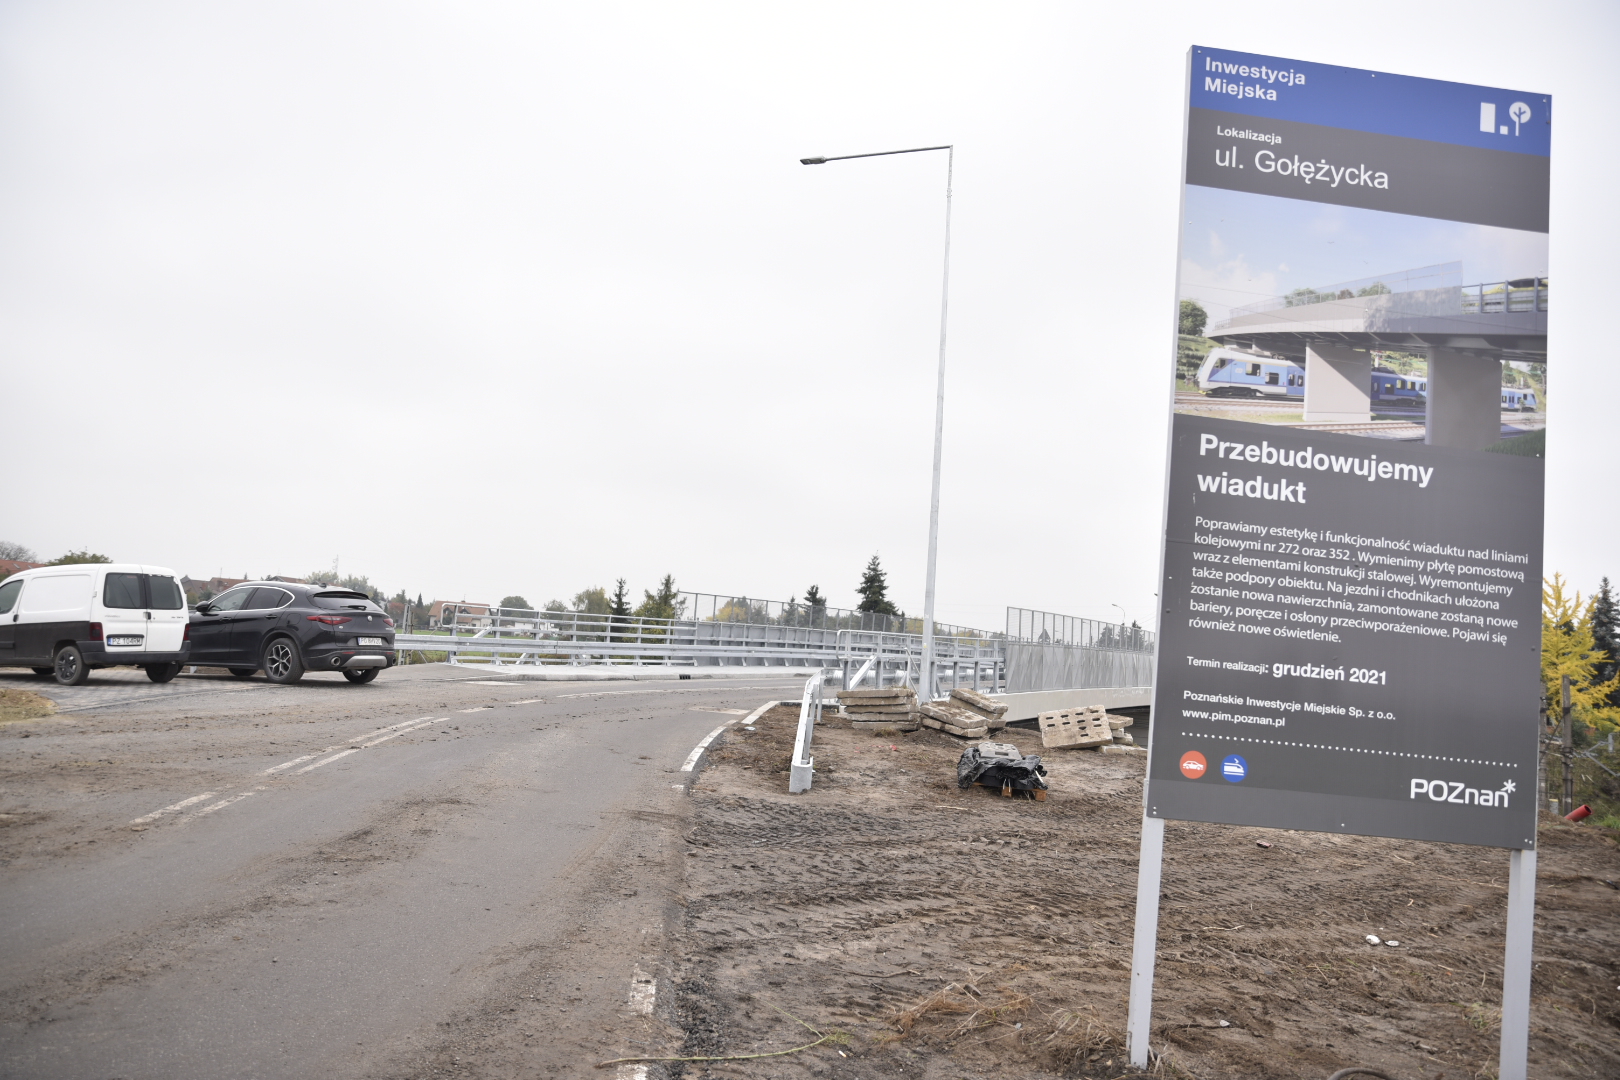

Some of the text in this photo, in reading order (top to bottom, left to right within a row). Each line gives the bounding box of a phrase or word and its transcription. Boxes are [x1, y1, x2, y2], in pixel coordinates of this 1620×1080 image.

[1205, 77, 1276, 101] Miejska
[1206, 57, 1305, 86] Inwestycja
[1217, 126, 1282, 145] Lokalizacja
[1216, 146, 1388, 189] ul. Gołężycka
[1200, 434, 1434, 488] Przebudowujemy
[1197, 472, 1306, 504] wiadukt
[1194, 532, 1261, 551] kolejowymi
[1264, 543, 1276, 551] nr
[1278, 542, 1299, 554] 272
[1302, 548, 1326, 558] oraz
[1329, 548, 1350, 560] 352
[1358, 551, 1425, 571] Wymienimy
[1427, 560, 1455, 574] płytę
[1458, 565, 1524, 582] pomostową
[1196, 516, 1268, 536] Poprawiamy
[1270, 527, 1318, 542] estetykę
[1326, 531, 1410, 551] funkcjonalność
[1413, 542, 1464, 557] wiaduktu
[1468, 549, 1488, 560] nad
[1492, 550, 1528, 564] liniami
[1192, 567, 1223, 579] także
[1226, 572, 1276, 587] podpory
[1278, 576, 1324, 590] obiektu.
[1327, 581, 1342, 592] Na
[1344, 583, 1379, 596] jezdni
[1387, 588, 1452, 604] chodnikach
[1455, 595, 1499, 610] ułożona
[1193, 552, 1221, 562] wraz
[1232, 554, 1301, 571] elementami
[1304, 561, 1365, 580] konstrukcji
[1368, 570, 1416, 586] stalowej.
[1419, 574, 1513, 597] Wyremontujemy
[1190, 585, 1518, 628] zostanie nowa nawierzchnia, zamontowane zostaną nowe
[1190, 599, 1233, 616] bariery,
[1236, 607, 1282, 620] poręcze
[1290, 611, 1328, 626] osłony
[1330, 617, 1450, 637] przeciwporażeniowe.
[1453, 628, 1489, 642] Pojawi
[1492, 632, 1507, 646] się
[1189, 617, 1341, 642] również nowe oświetlenie.
[1187, 656, 1386, 685] Termin realizacji: grudzień 2021
[1182, 710, 1285, 728] www.pim.poznan.pl
[1184, 690, 1244, 705] Poznańskie
[1246, 696, 1301, 712] Inwestycje
[1304, 702, 1346, 715] Miejskie
[1348, 707, 1365, 718] Sp.
[1377, 712, 1396, 720] o.o.
